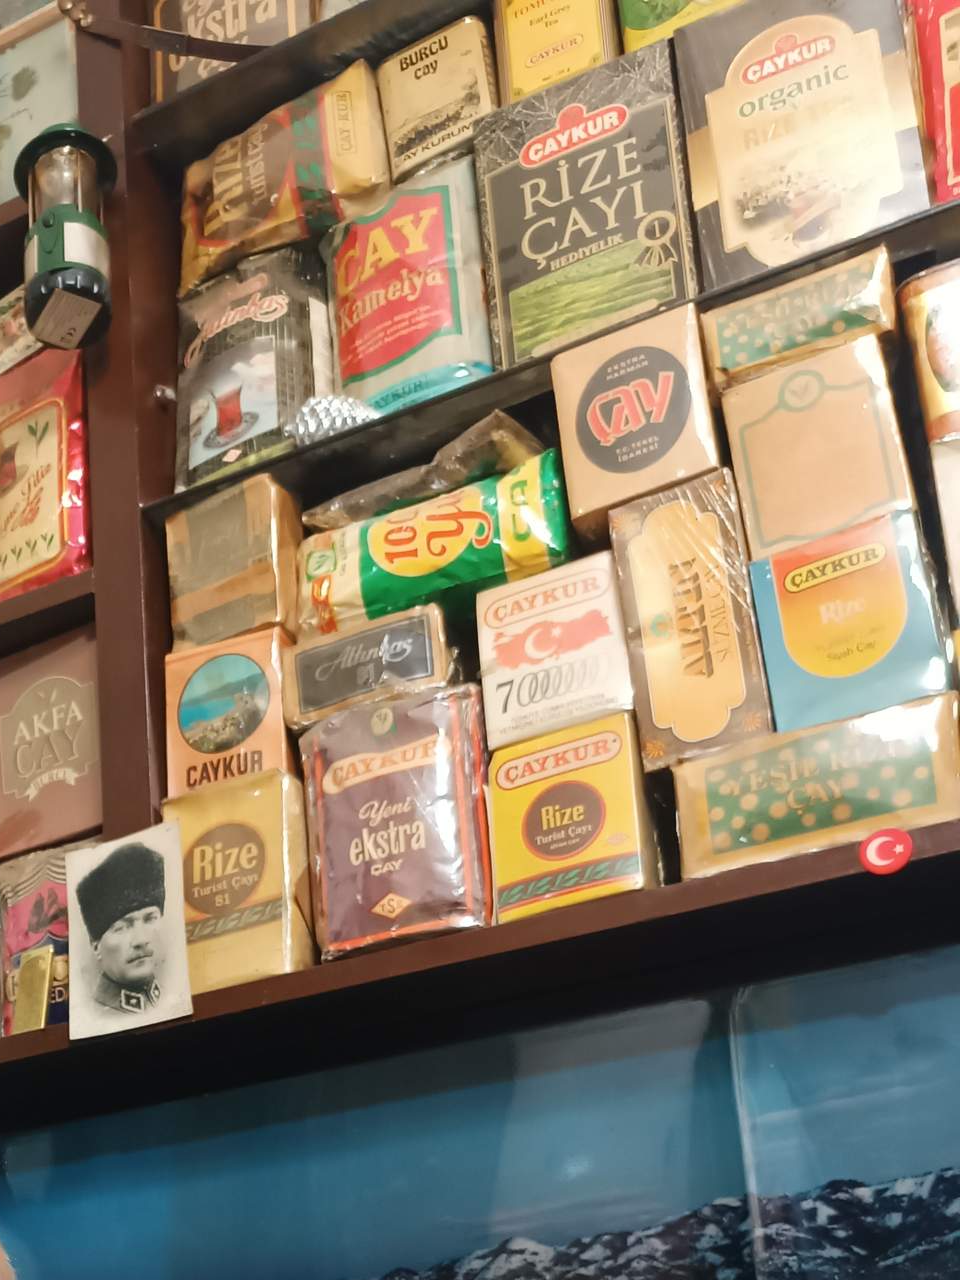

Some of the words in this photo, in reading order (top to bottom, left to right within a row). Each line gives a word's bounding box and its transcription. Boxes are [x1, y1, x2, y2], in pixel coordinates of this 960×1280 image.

[399, 35, 449, 72] BURCU
[738, 64, 850, 118] organic
[528, 111, 621, 164] ÇAYKUR
[519, 137, 641, 221] RİZE
[520, 180, 649, 271] ÇAYI
[339, 265, 446, 337] Kamelya
[789, 548, 880, 588] ÇAYKUR
[13, 700, 84, 746] AKFA
[186, 750, 263, 789] CAYKUR
[503, 738, 611, 784] ÇAYKUR
[358, 797, 412, 828] Yeni
[535, 828, 567, 846] Turist
[567, 824, 593, 839] Çayı
[541, 803, 586, 831] Rize
[192, 841, 259, 885] Rize
[349, 820, 427, 867] ekstra
[191, 877, 228, 899] Turist
